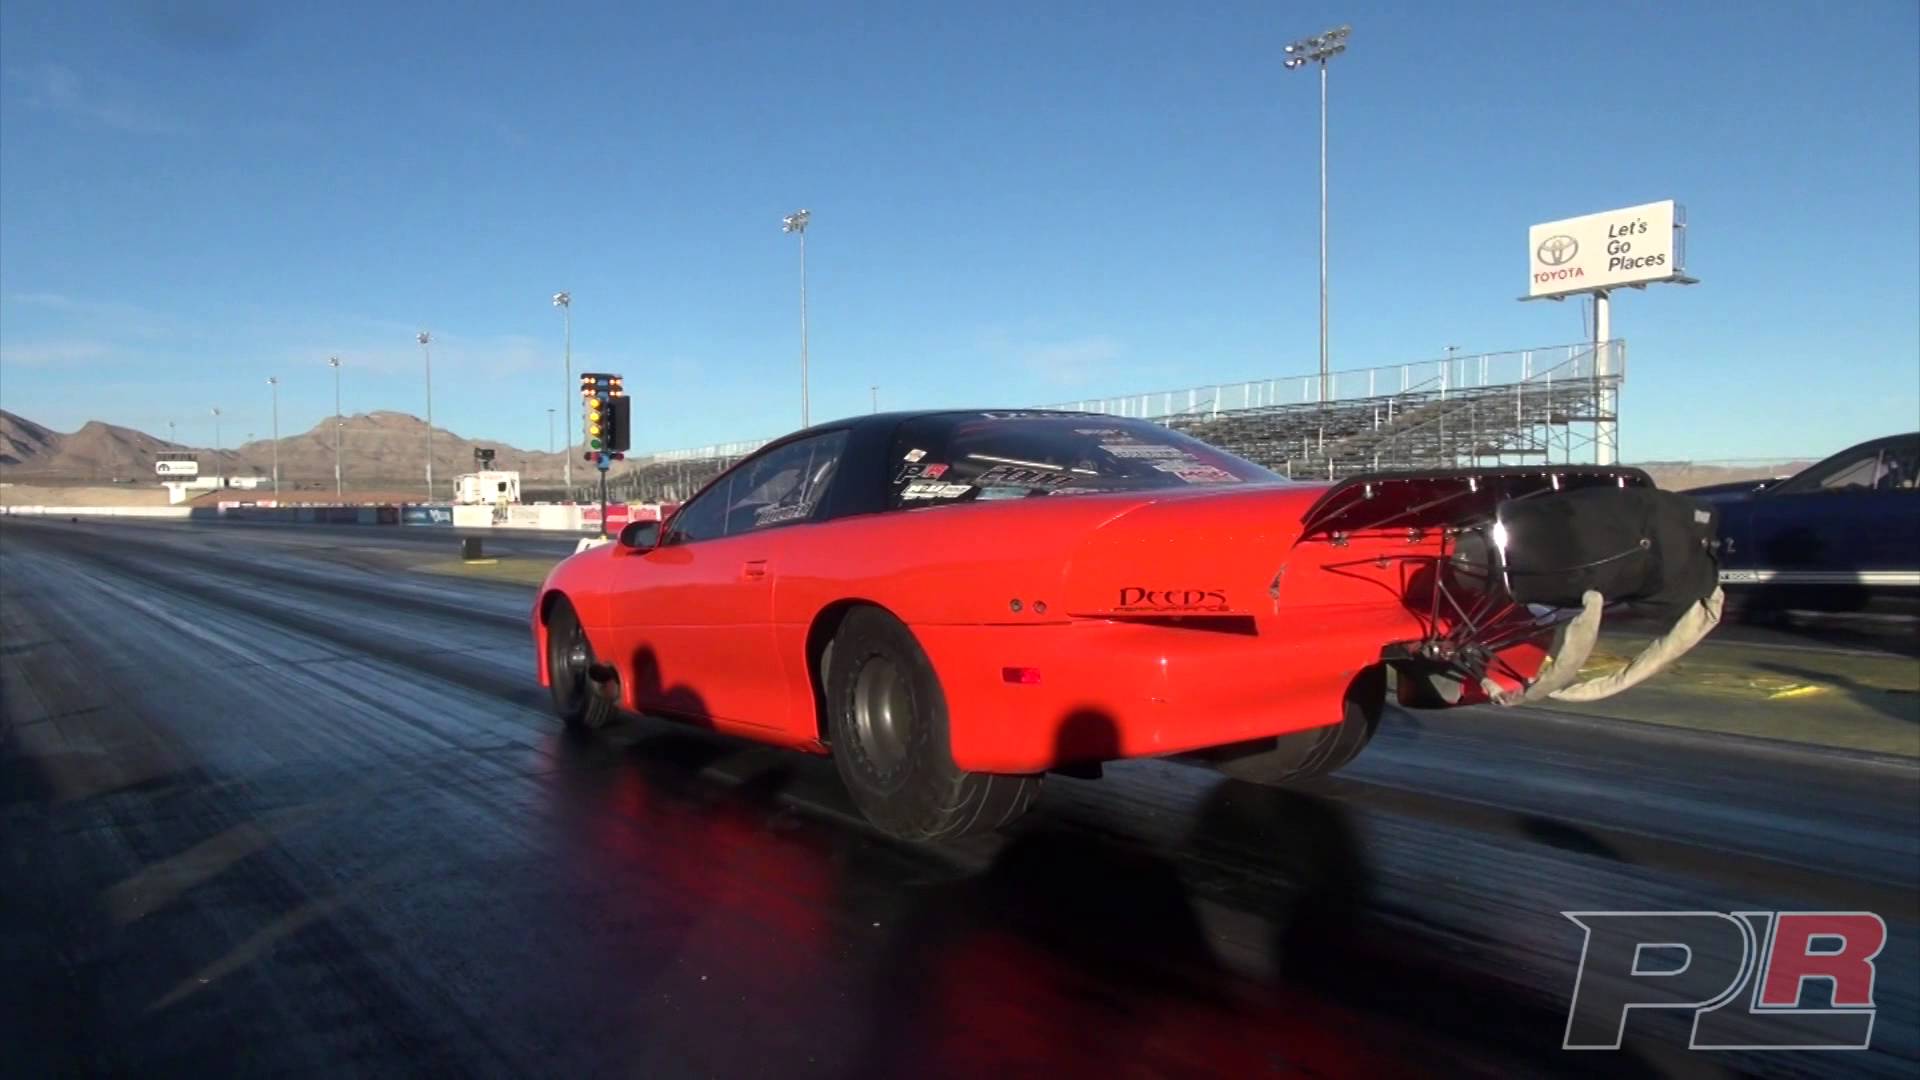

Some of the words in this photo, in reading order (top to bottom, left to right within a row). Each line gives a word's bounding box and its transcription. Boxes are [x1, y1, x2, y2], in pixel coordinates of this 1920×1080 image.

[1608, 218, 1648, 239] Let's
[1607, 240, 1631, 255] Go
[1608, 253, 1666, 272] Places
[1533, 267, 1584, 284] TOYOTA
